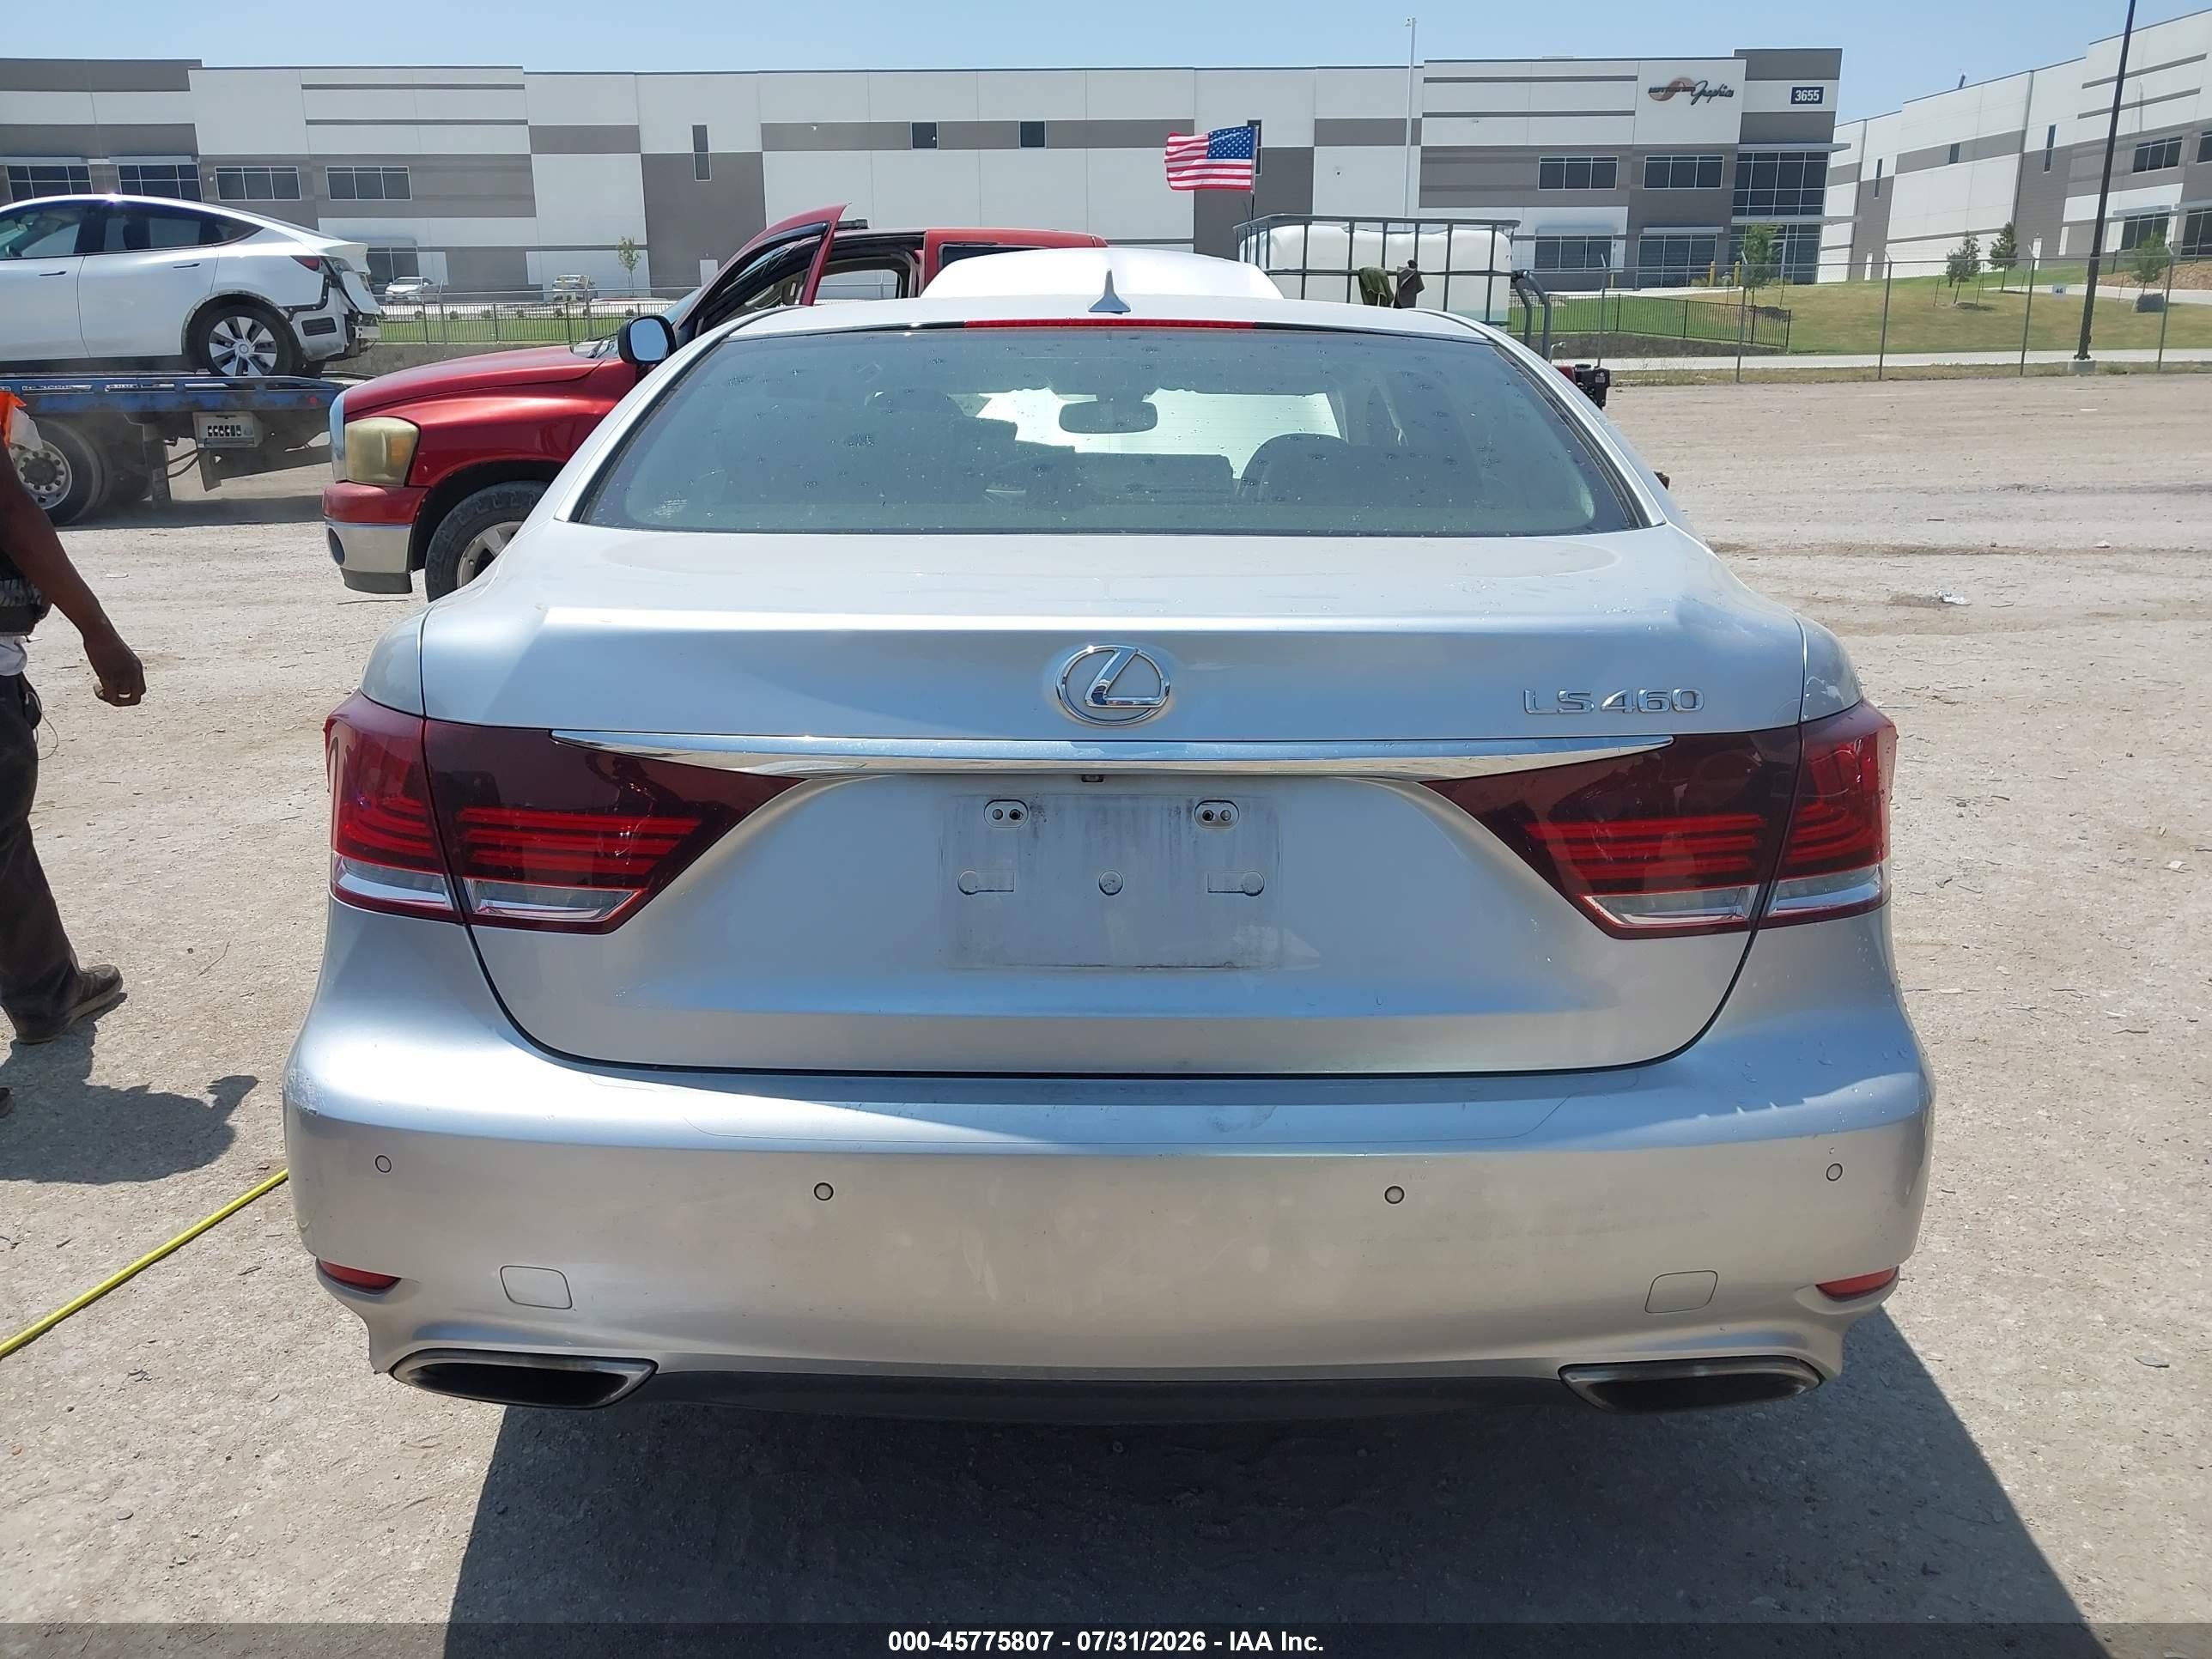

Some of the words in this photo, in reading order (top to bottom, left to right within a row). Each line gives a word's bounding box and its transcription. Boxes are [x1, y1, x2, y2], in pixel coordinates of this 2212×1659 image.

[1795, 89, 1820, 101] 3655
[1522, 689, 1595, 714] LS
[1600, 688, 1705, 714] 460
